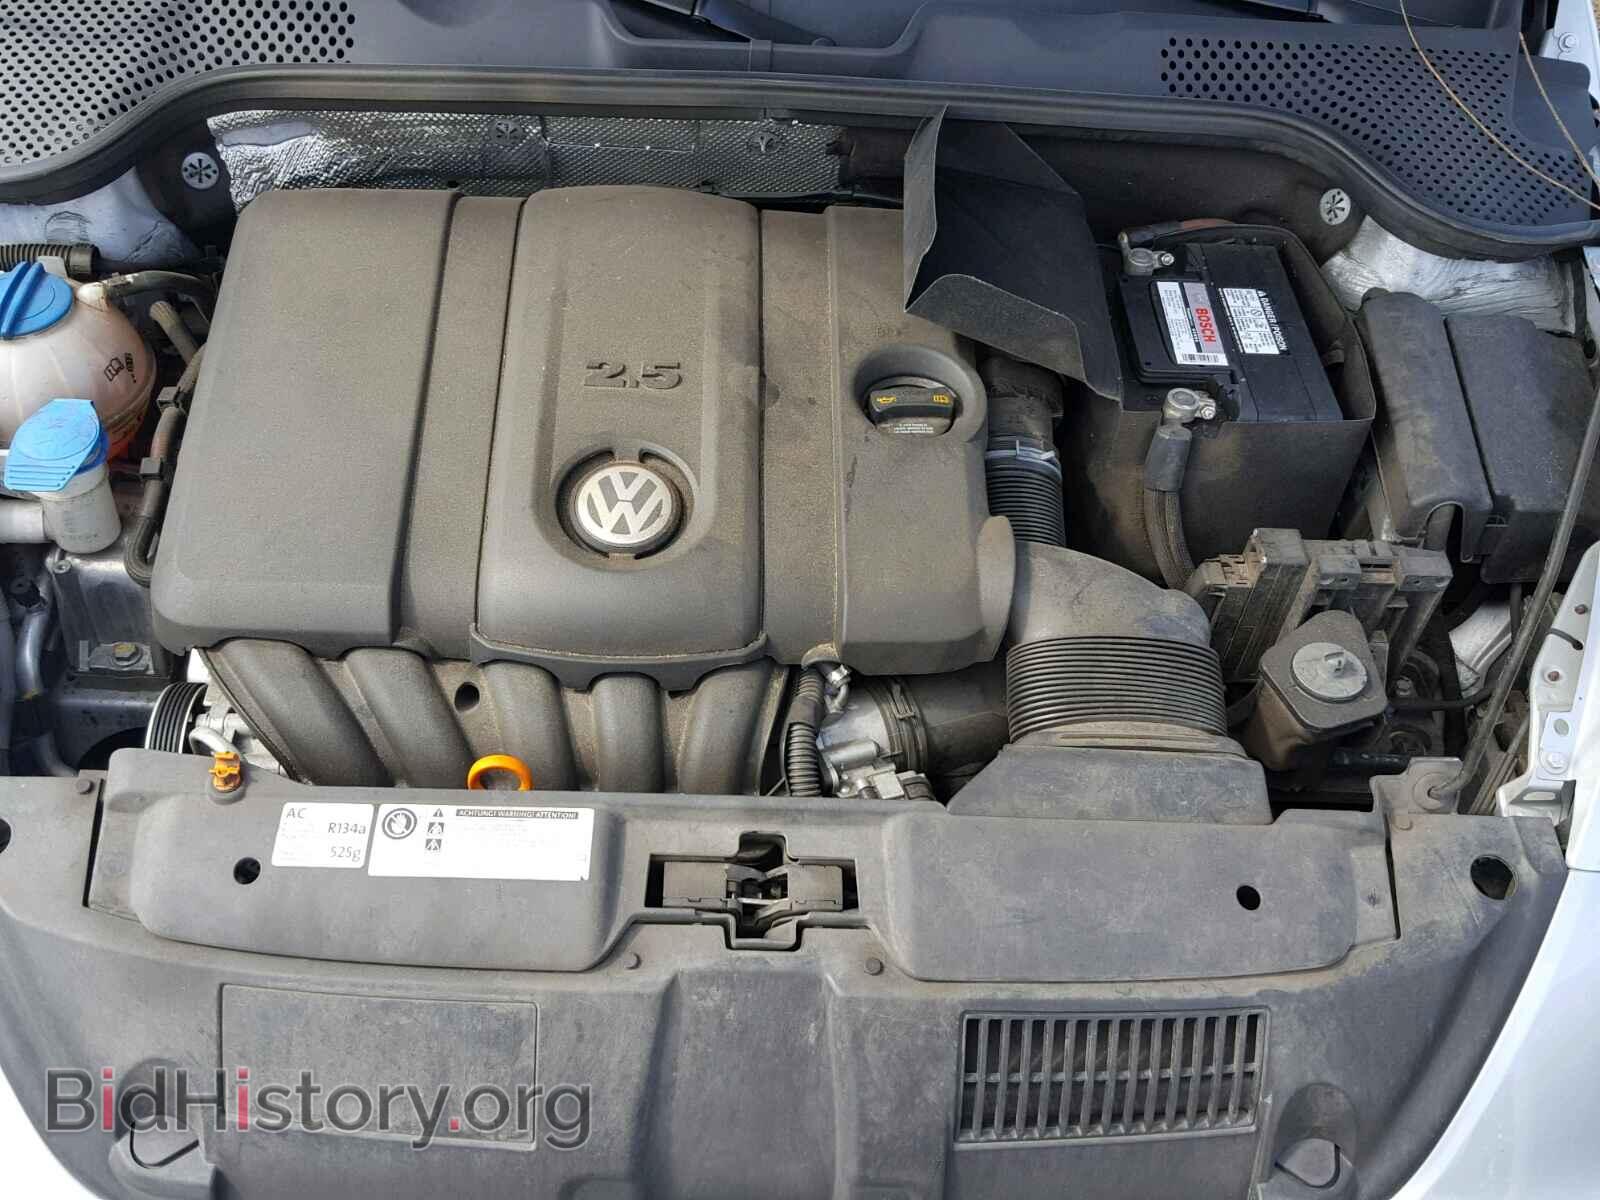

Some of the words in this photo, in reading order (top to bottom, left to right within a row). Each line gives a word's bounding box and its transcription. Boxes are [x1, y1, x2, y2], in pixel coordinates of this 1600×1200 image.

[1196, 308, 1216, 342] BOSCH
[584, 360, 682, 389] 2.5
[286, 807, 308, 819] AC
[328, 822, 366, 834] R134a
[329, 846, 361, 862] 525g
